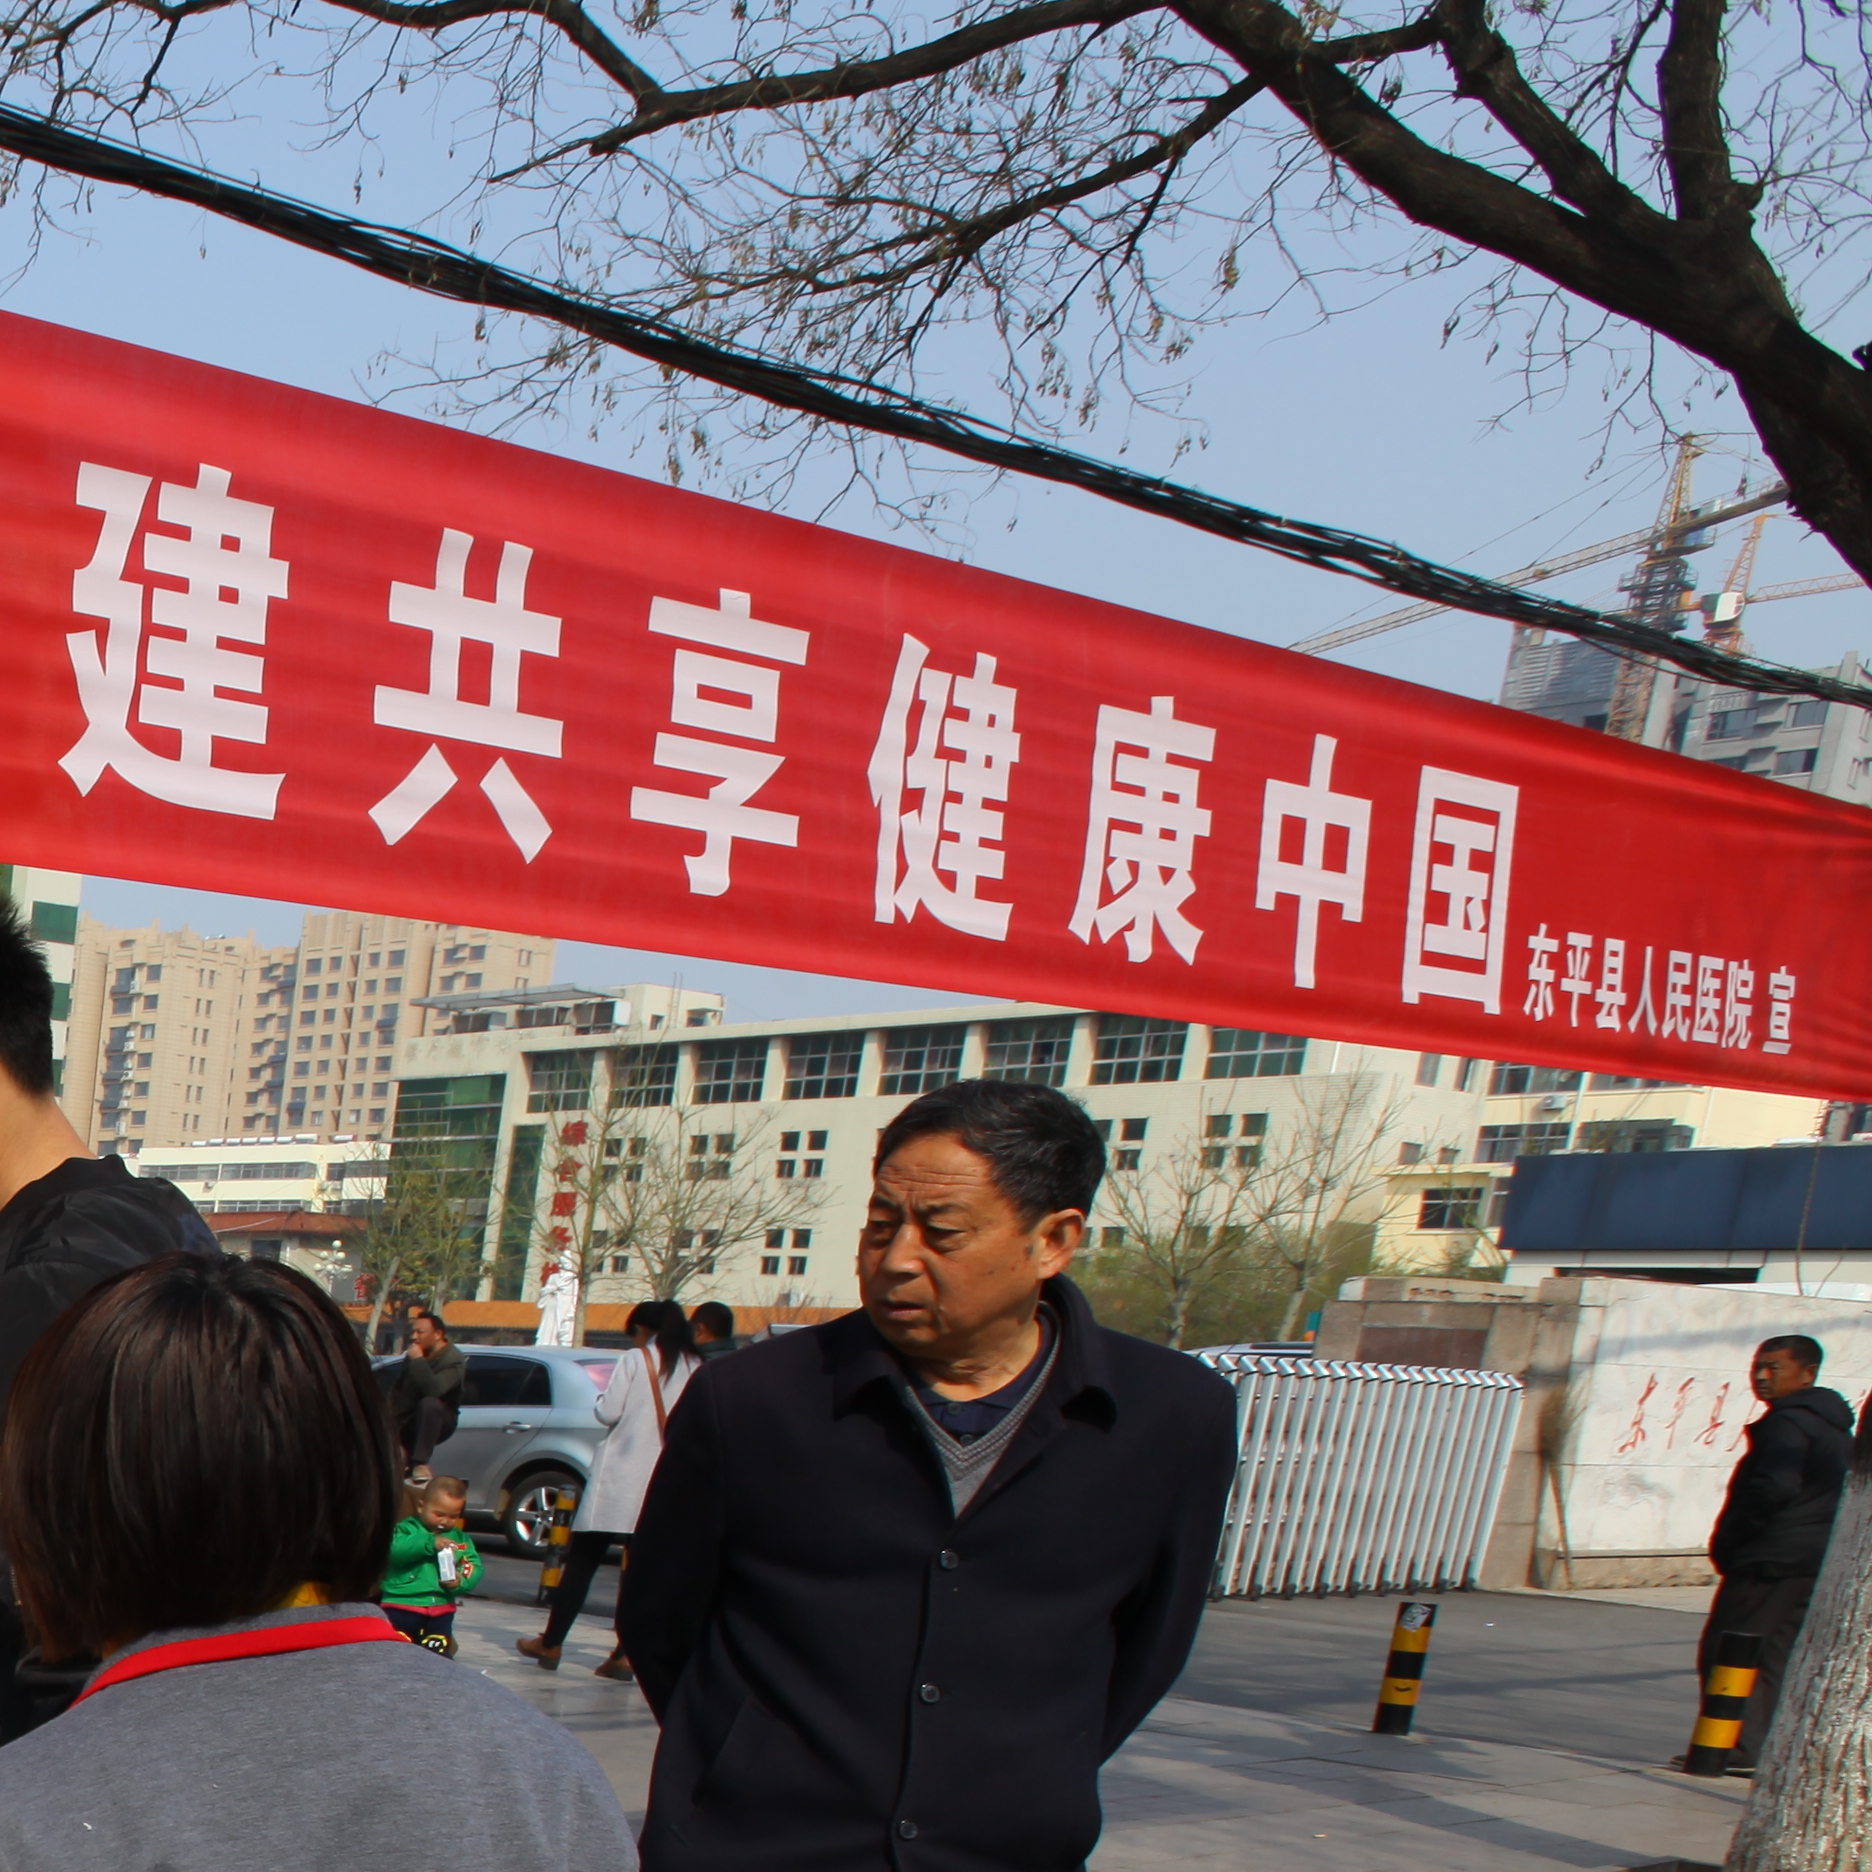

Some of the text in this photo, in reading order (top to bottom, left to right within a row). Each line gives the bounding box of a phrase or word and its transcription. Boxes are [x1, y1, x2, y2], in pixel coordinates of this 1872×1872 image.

[1522, 922, 1797, 1055] 东平县人民医院 宣
